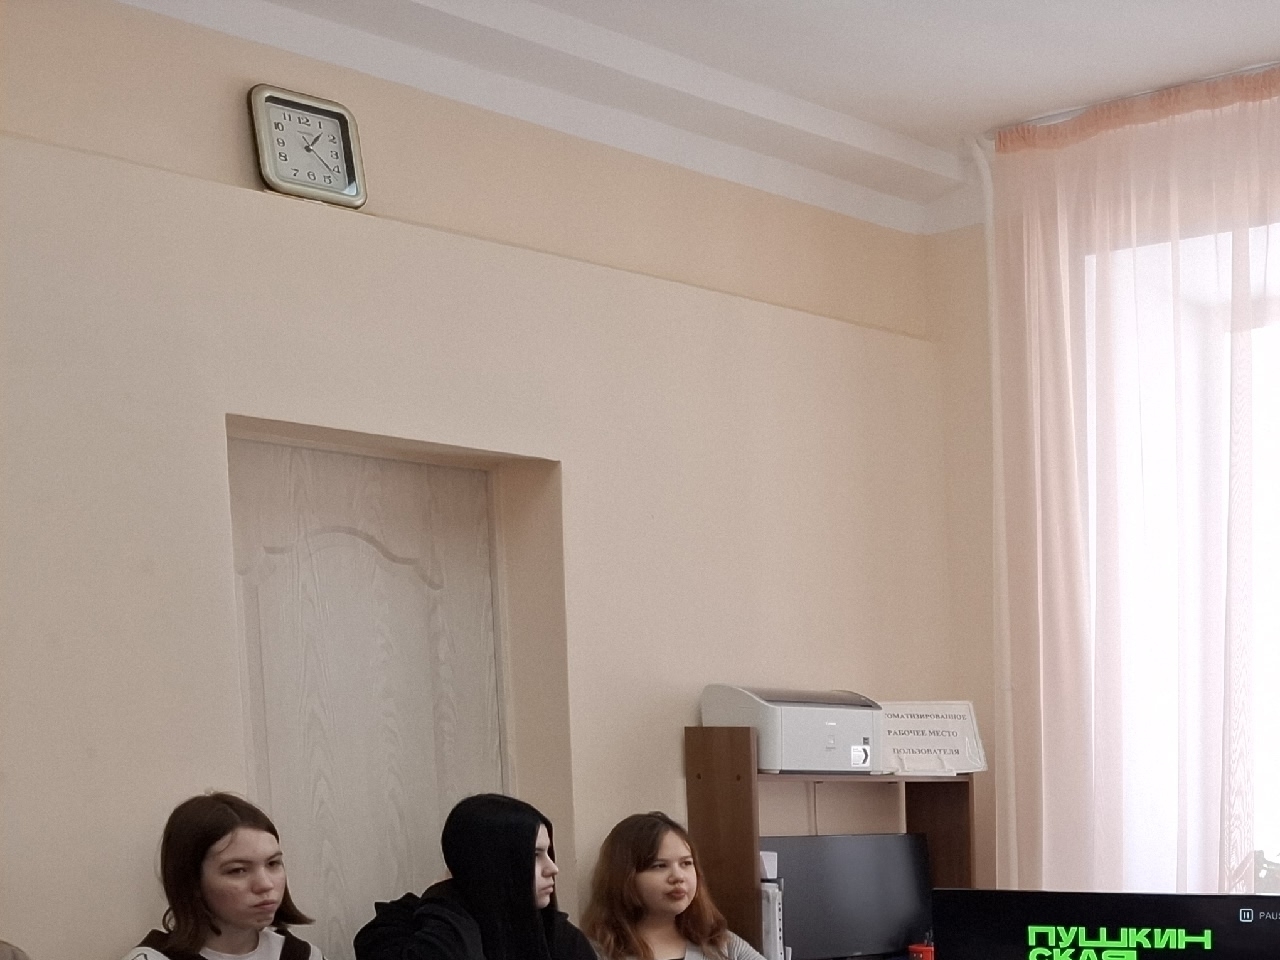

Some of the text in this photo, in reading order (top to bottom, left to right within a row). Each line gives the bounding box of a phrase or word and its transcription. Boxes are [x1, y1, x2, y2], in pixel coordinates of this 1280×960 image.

[282, 112, 292, 122] 11
[297, 116, 311, 127] 12
[274, 121, 285, 132] 10
[276, 138, 285, 147] 9
[328, 134, 337, 144] 2
[278, 152, 288, 162] 8
[330, 150, 339, 160] 3
[291, 168, 299, 177] 7
[332, 165, 341, 174] 4
[307, 171, 316, 181] 6
[323, 175, 332, 185] 5
[887, 729, 927, 737] РАБОЧЕЕ
[1027, 925, 1212, 950] ПУШКИН
